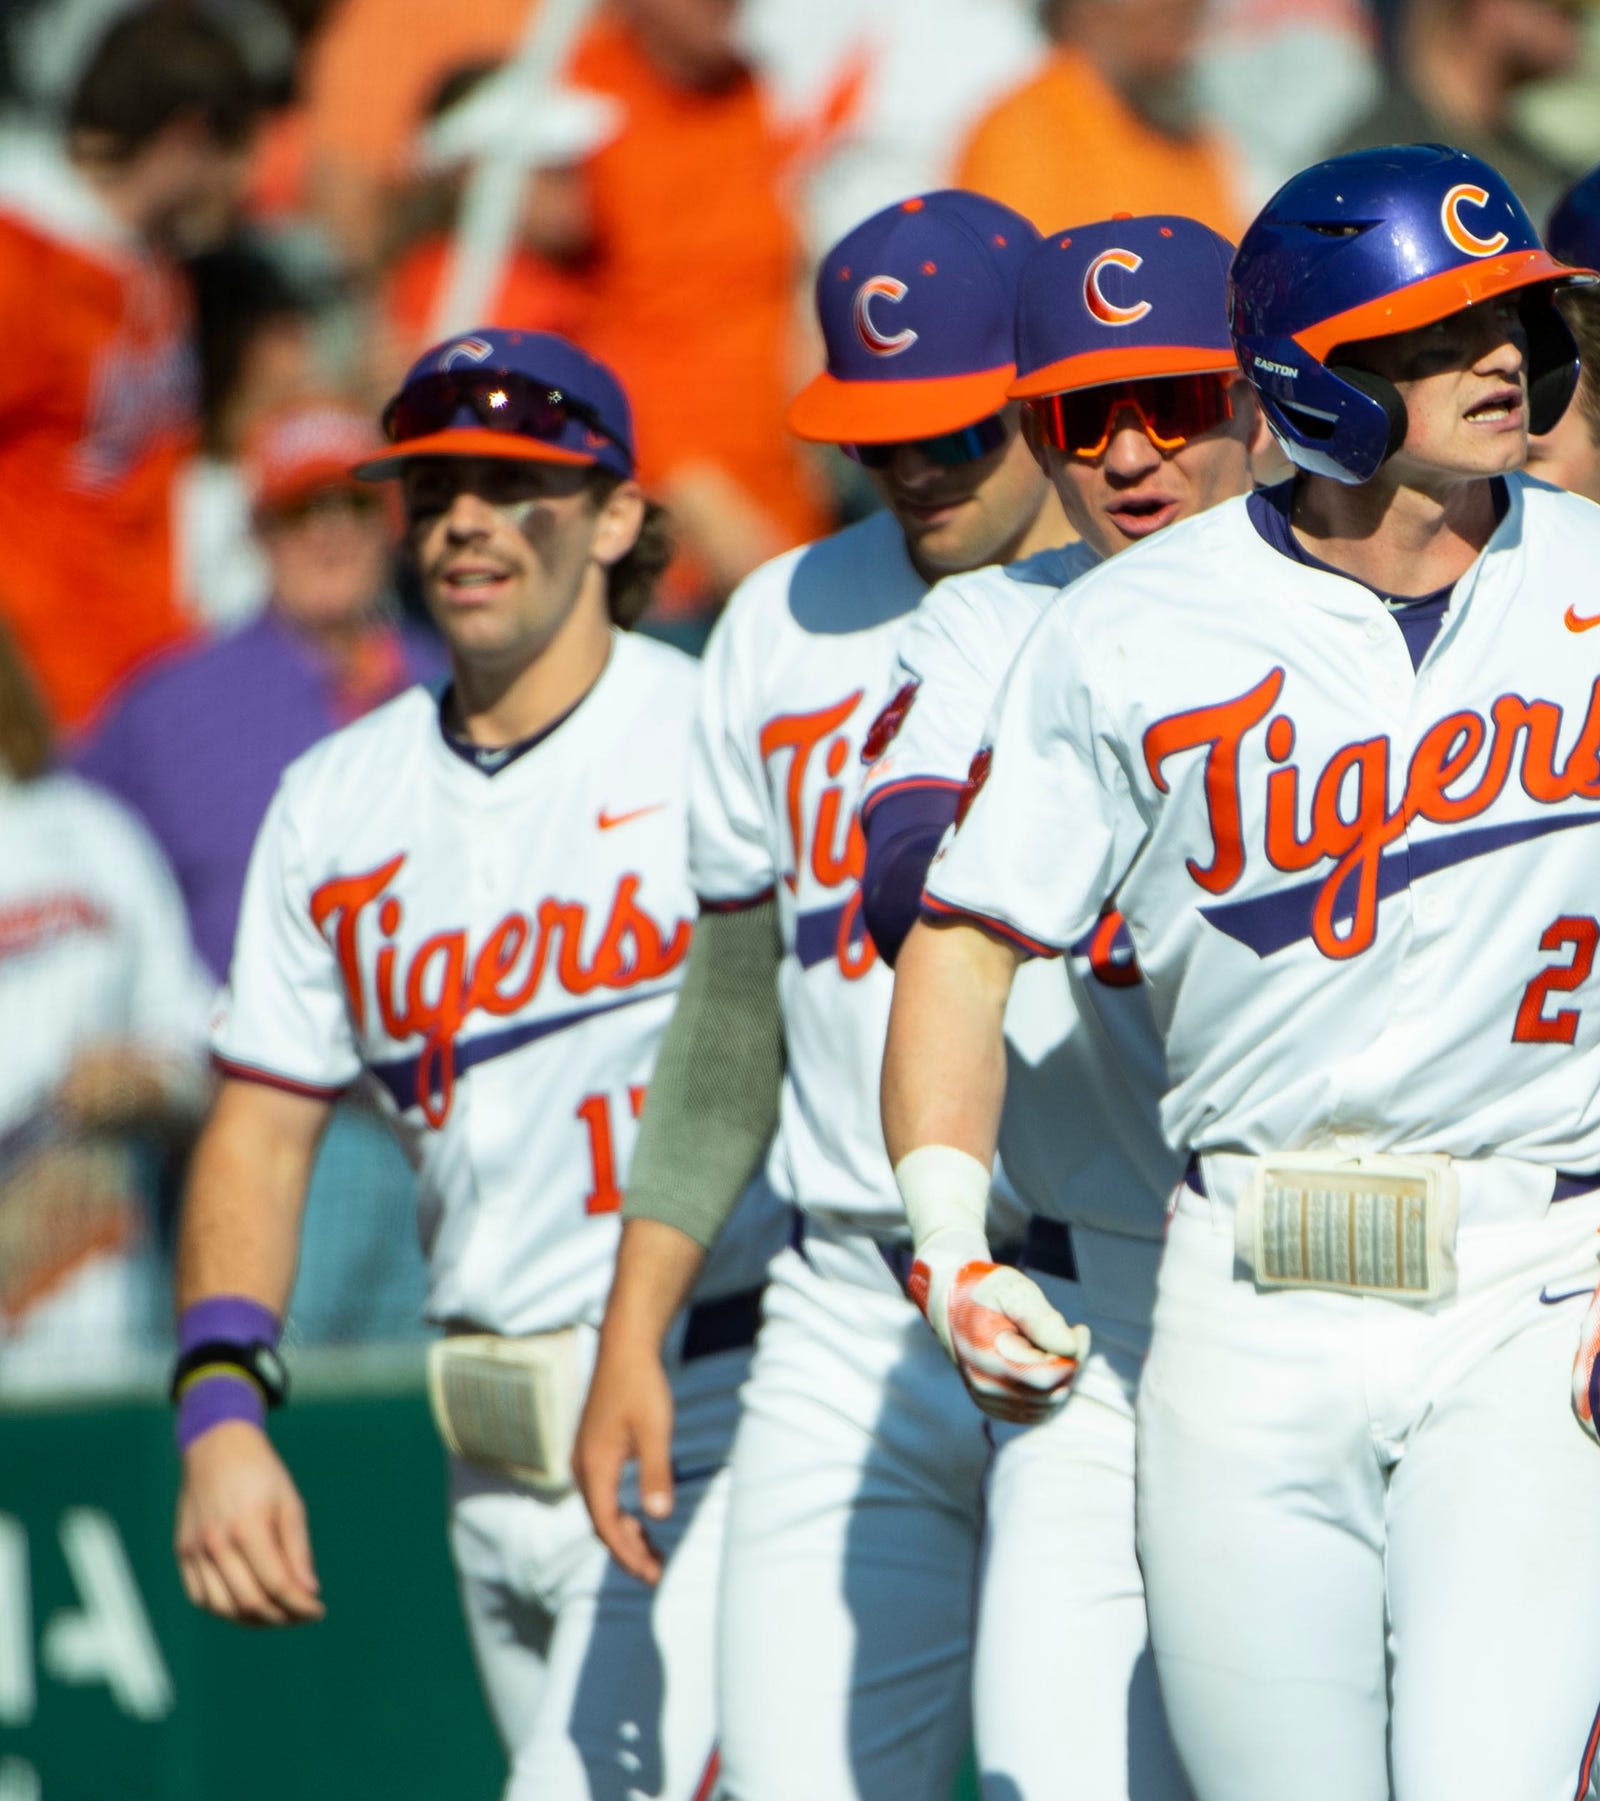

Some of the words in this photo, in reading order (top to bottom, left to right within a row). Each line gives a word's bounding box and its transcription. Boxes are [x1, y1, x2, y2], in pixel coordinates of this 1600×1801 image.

[1441, 183, 1510, 257] C
[854, 275, 918, 357] C
[1083, 248, 1152, 326] C
[1254, 356, 1299, 378] EASTON
[309, 852, 690, 1131] Tigers
[576, 1085, 649, 1216] 1
